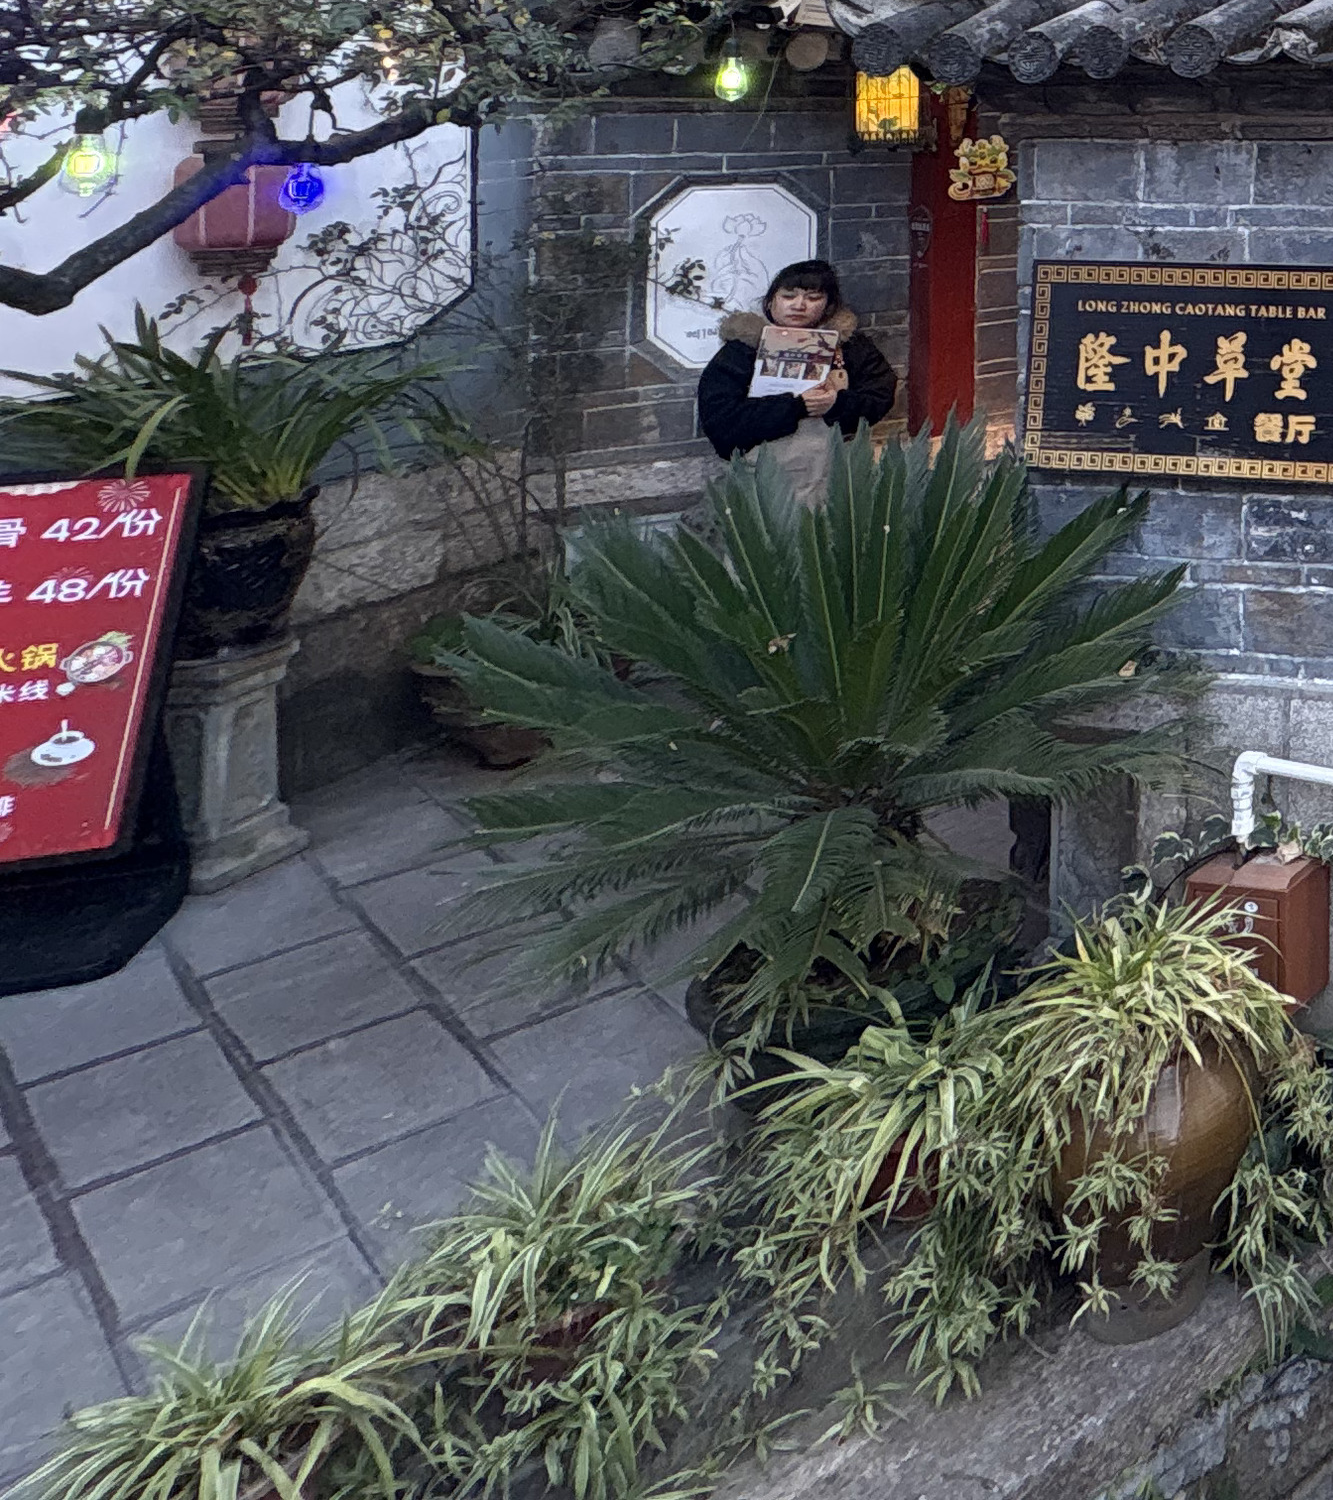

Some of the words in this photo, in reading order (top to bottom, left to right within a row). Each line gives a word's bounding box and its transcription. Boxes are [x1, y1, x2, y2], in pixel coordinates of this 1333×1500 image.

[1077, 300, 1117, 313] LONG
[1120, 301, 1172, 315] ZHONG
[1175, 302, 1246, 317] CAOTANG
[1249, 304, 1294, 319] TABLE
[1297, 306, 1327, 320] BAR
[1075, 329, 1318, 402] 隆中草堂
[1253, 411, 1317, 444] 餐厅
[40, 506, 163, 544] 42/份
[26, 567, 151, 605] 48/份
